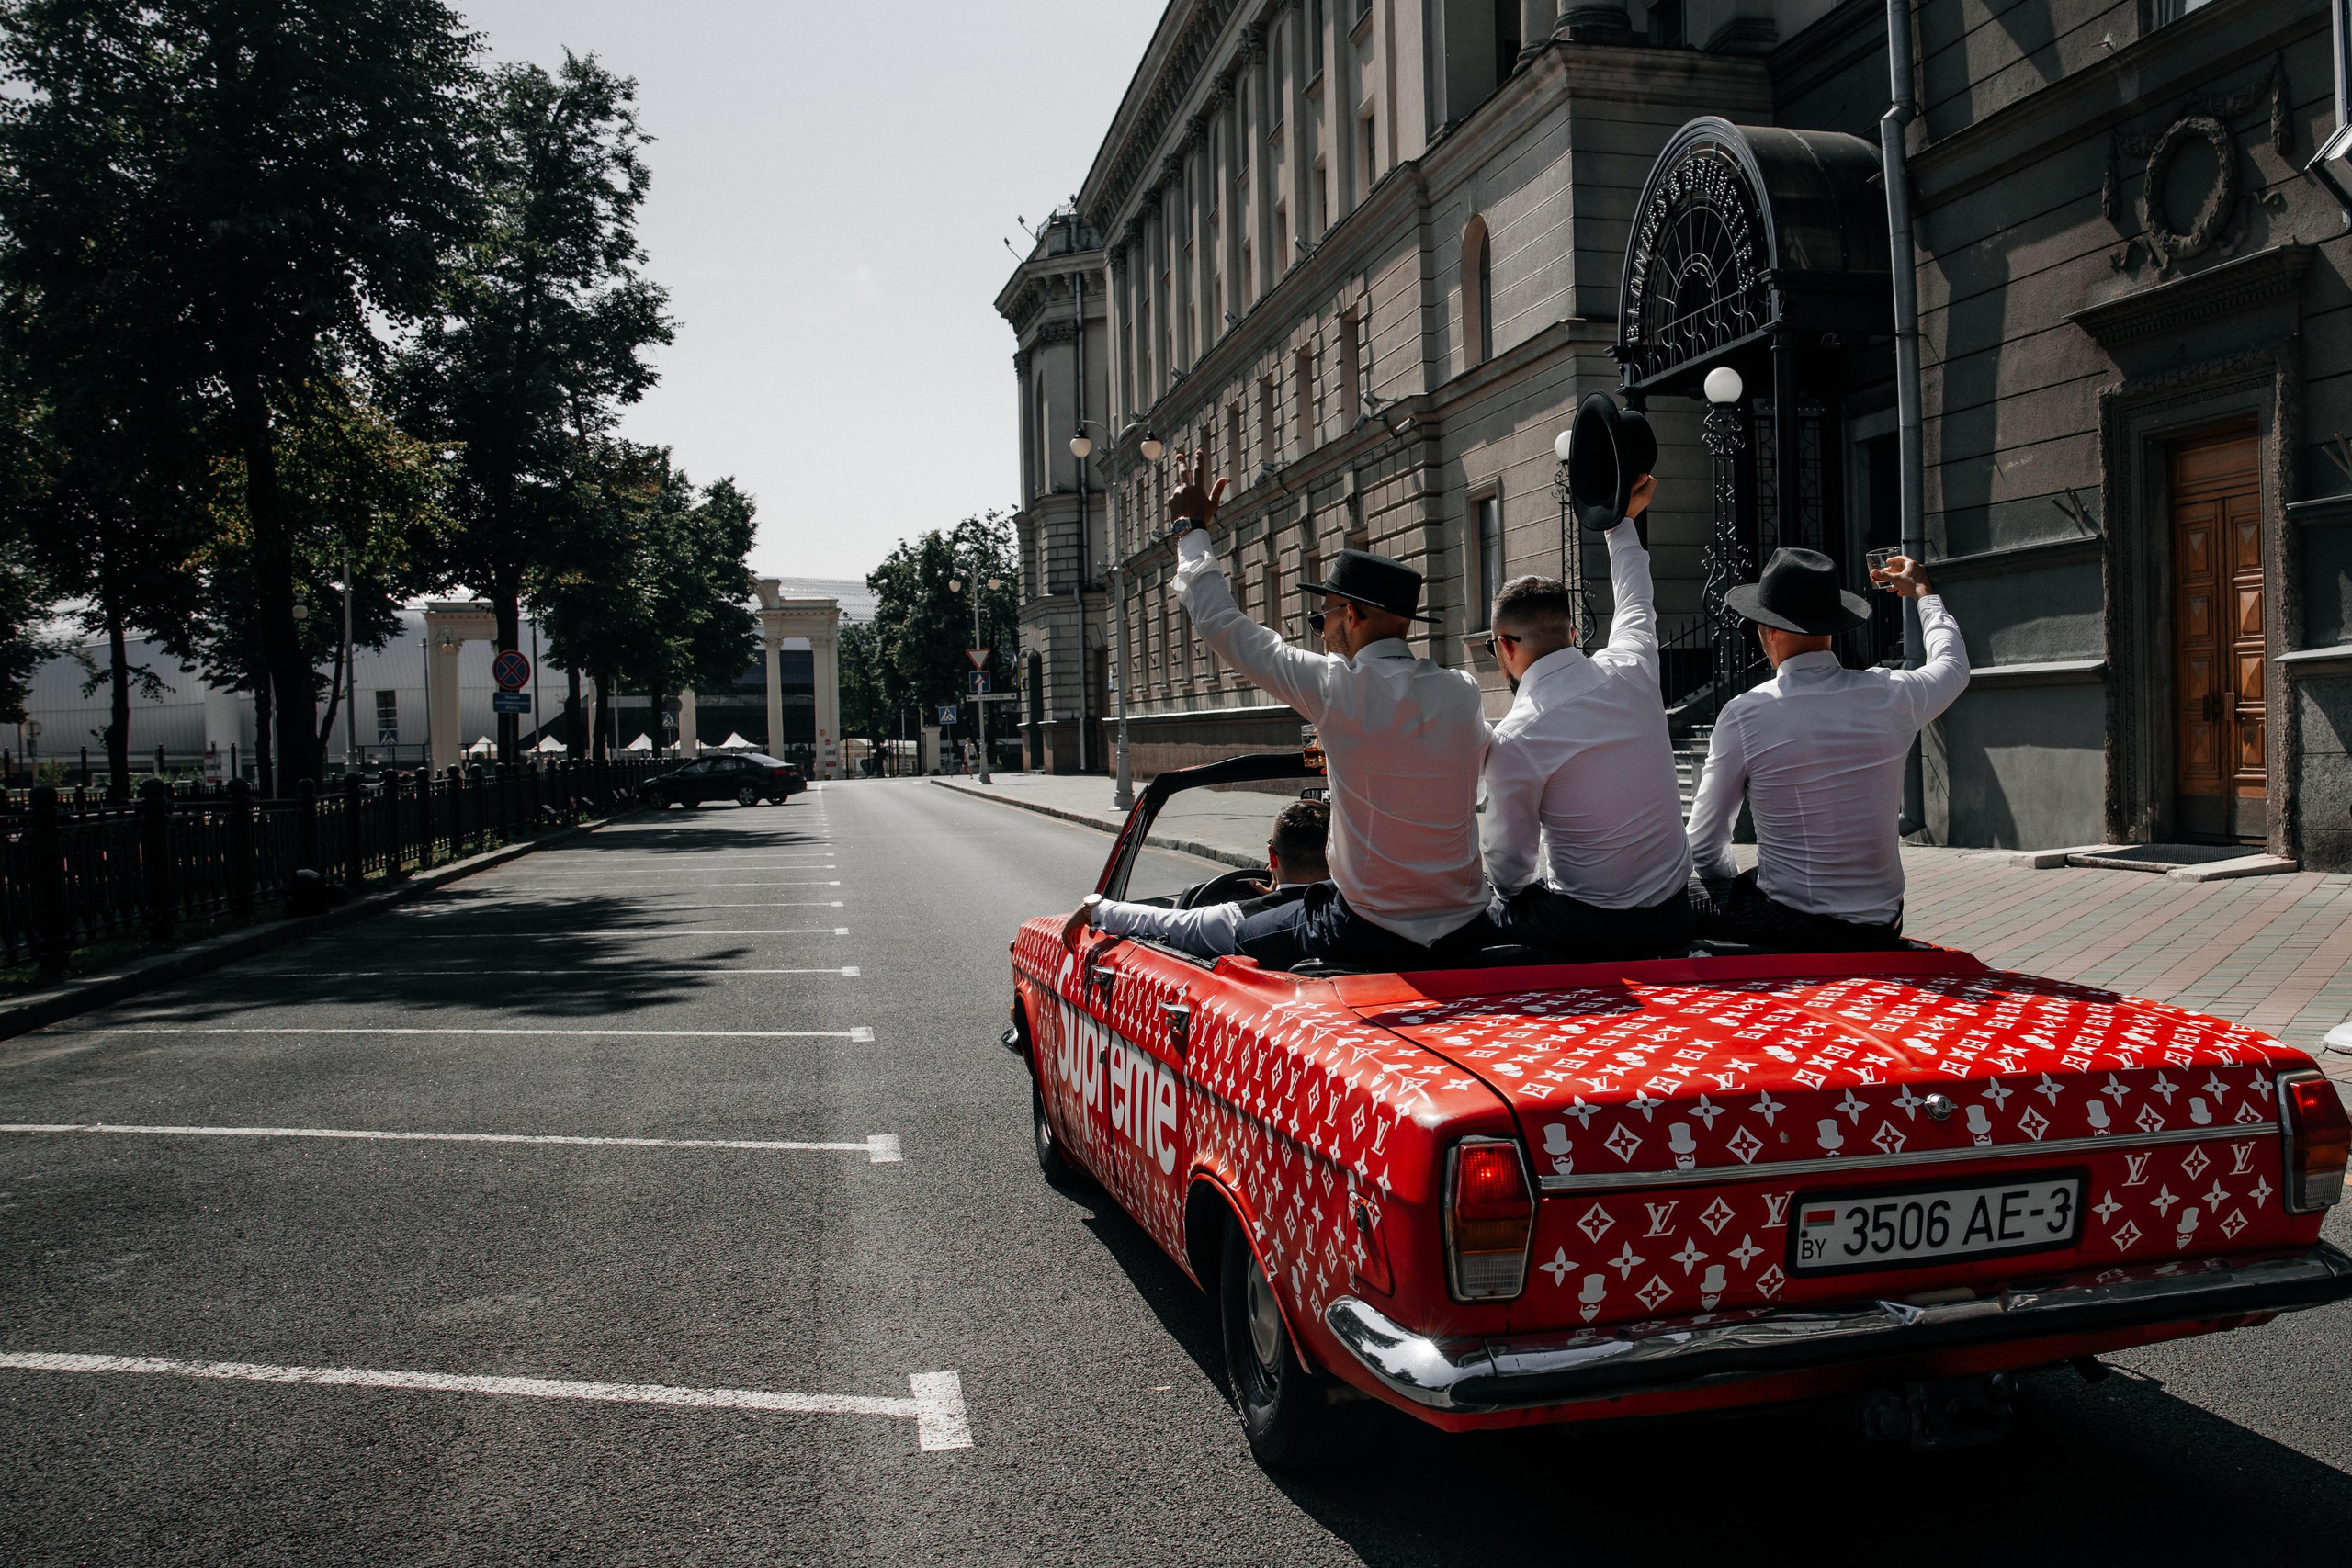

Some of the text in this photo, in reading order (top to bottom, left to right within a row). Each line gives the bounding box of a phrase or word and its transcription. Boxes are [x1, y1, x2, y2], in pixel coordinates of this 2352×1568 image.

[1627, 187, 1668, 344] BLONDES
[1684, 156, 1756, 293] BRUNETTES
[1057, 953, 1177, 1176] Supreme
[1801, 1238, 1827, 1260] BY
[1843, 1186, 2072, 1256] 3506 AE-3
